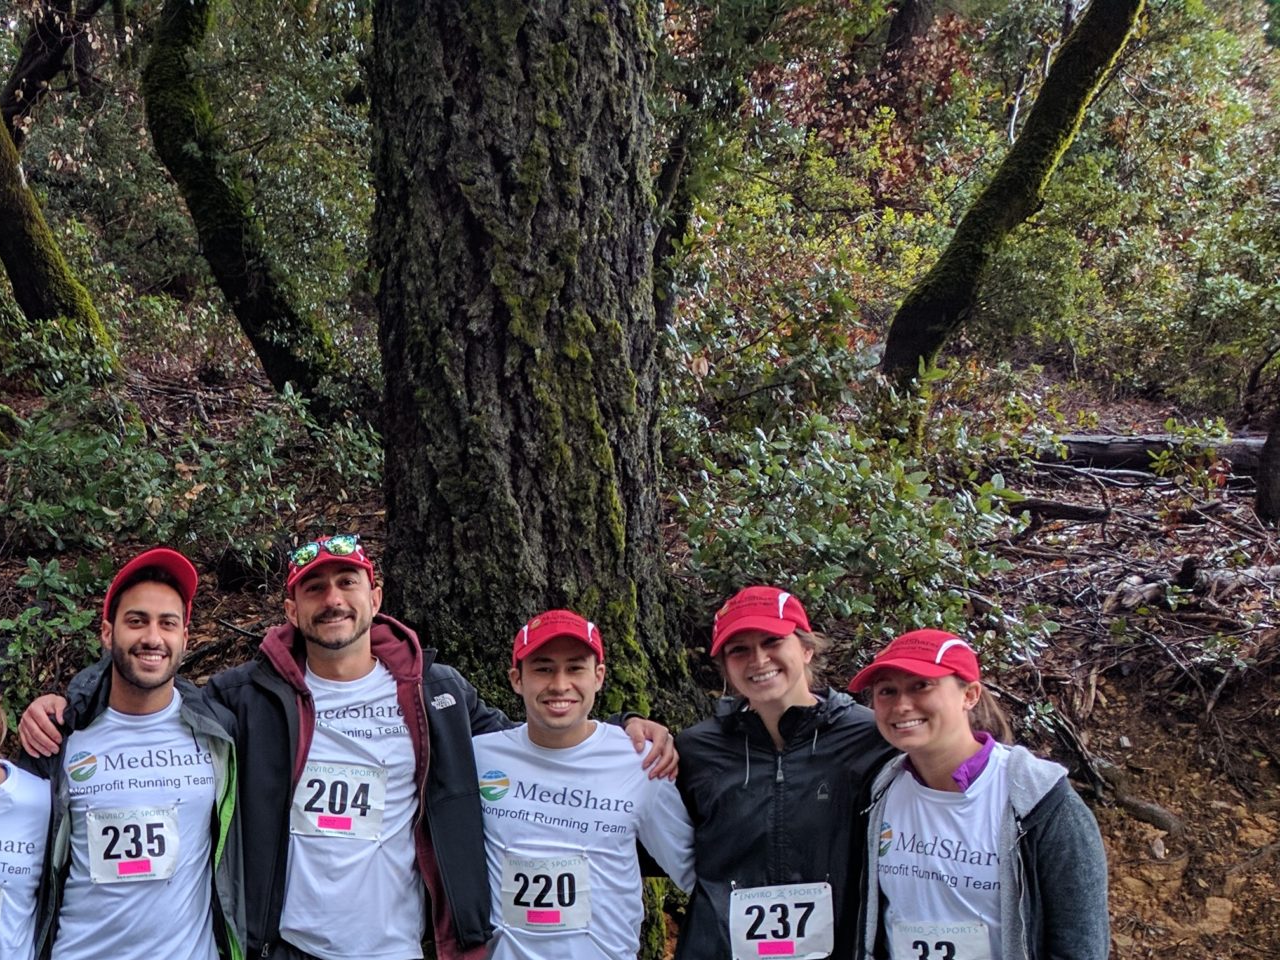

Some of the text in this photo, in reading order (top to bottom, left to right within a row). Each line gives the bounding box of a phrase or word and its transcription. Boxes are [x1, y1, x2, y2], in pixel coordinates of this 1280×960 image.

[316, 702, 404, 720] edShare
[103, 748, 213, 772] MedShare
[306, 765, 335, 775] NVIRO
[128, 776, 181, 789] Running
[184, 774, 214, 786] Team
[303, 778, 372, 817] 204
[513, 781, 634, 814] MedShare
[533, 811, 589, 834] Running
[593, 820, 628, 835] Team
[101, 822, 167, 861] 235
[894, 832, 1001, 867] MedShar
[0, 861, 31, 876] Team
[911, 865, 959, 888] Running
[512, 871, 576, 908] 220
[744, 901, 815, 941] 237
